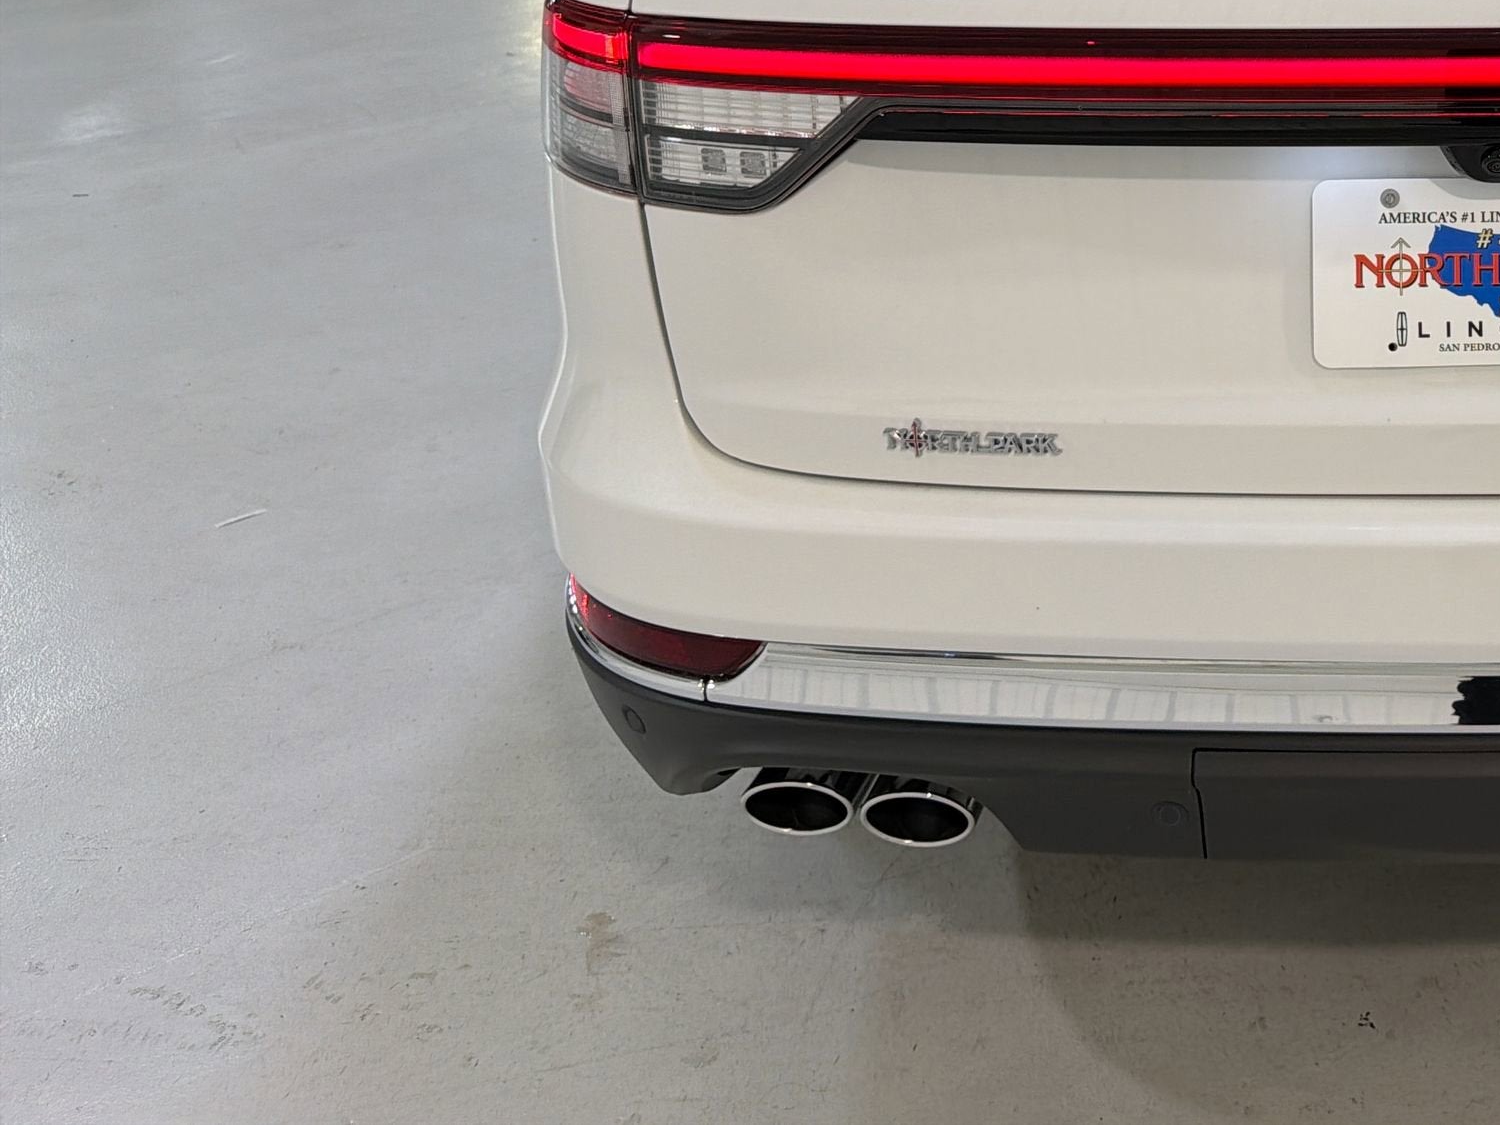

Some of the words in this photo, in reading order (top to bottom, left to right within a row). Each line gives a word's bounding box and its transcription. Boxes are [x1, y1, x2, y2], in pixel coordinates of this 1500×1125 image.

[1378, 211, 1457, 224] AMERICA'S
[1460, 210, 1475, 223] #1
[1353, 250, 1500, 289] NORTH
[1438, 342, 1460, 352] SAN
[1463, 342, 1500, 352] PEDRO
[883, 426, 978, 454] NORTH
[986, 431, 1063, 455] PARK
